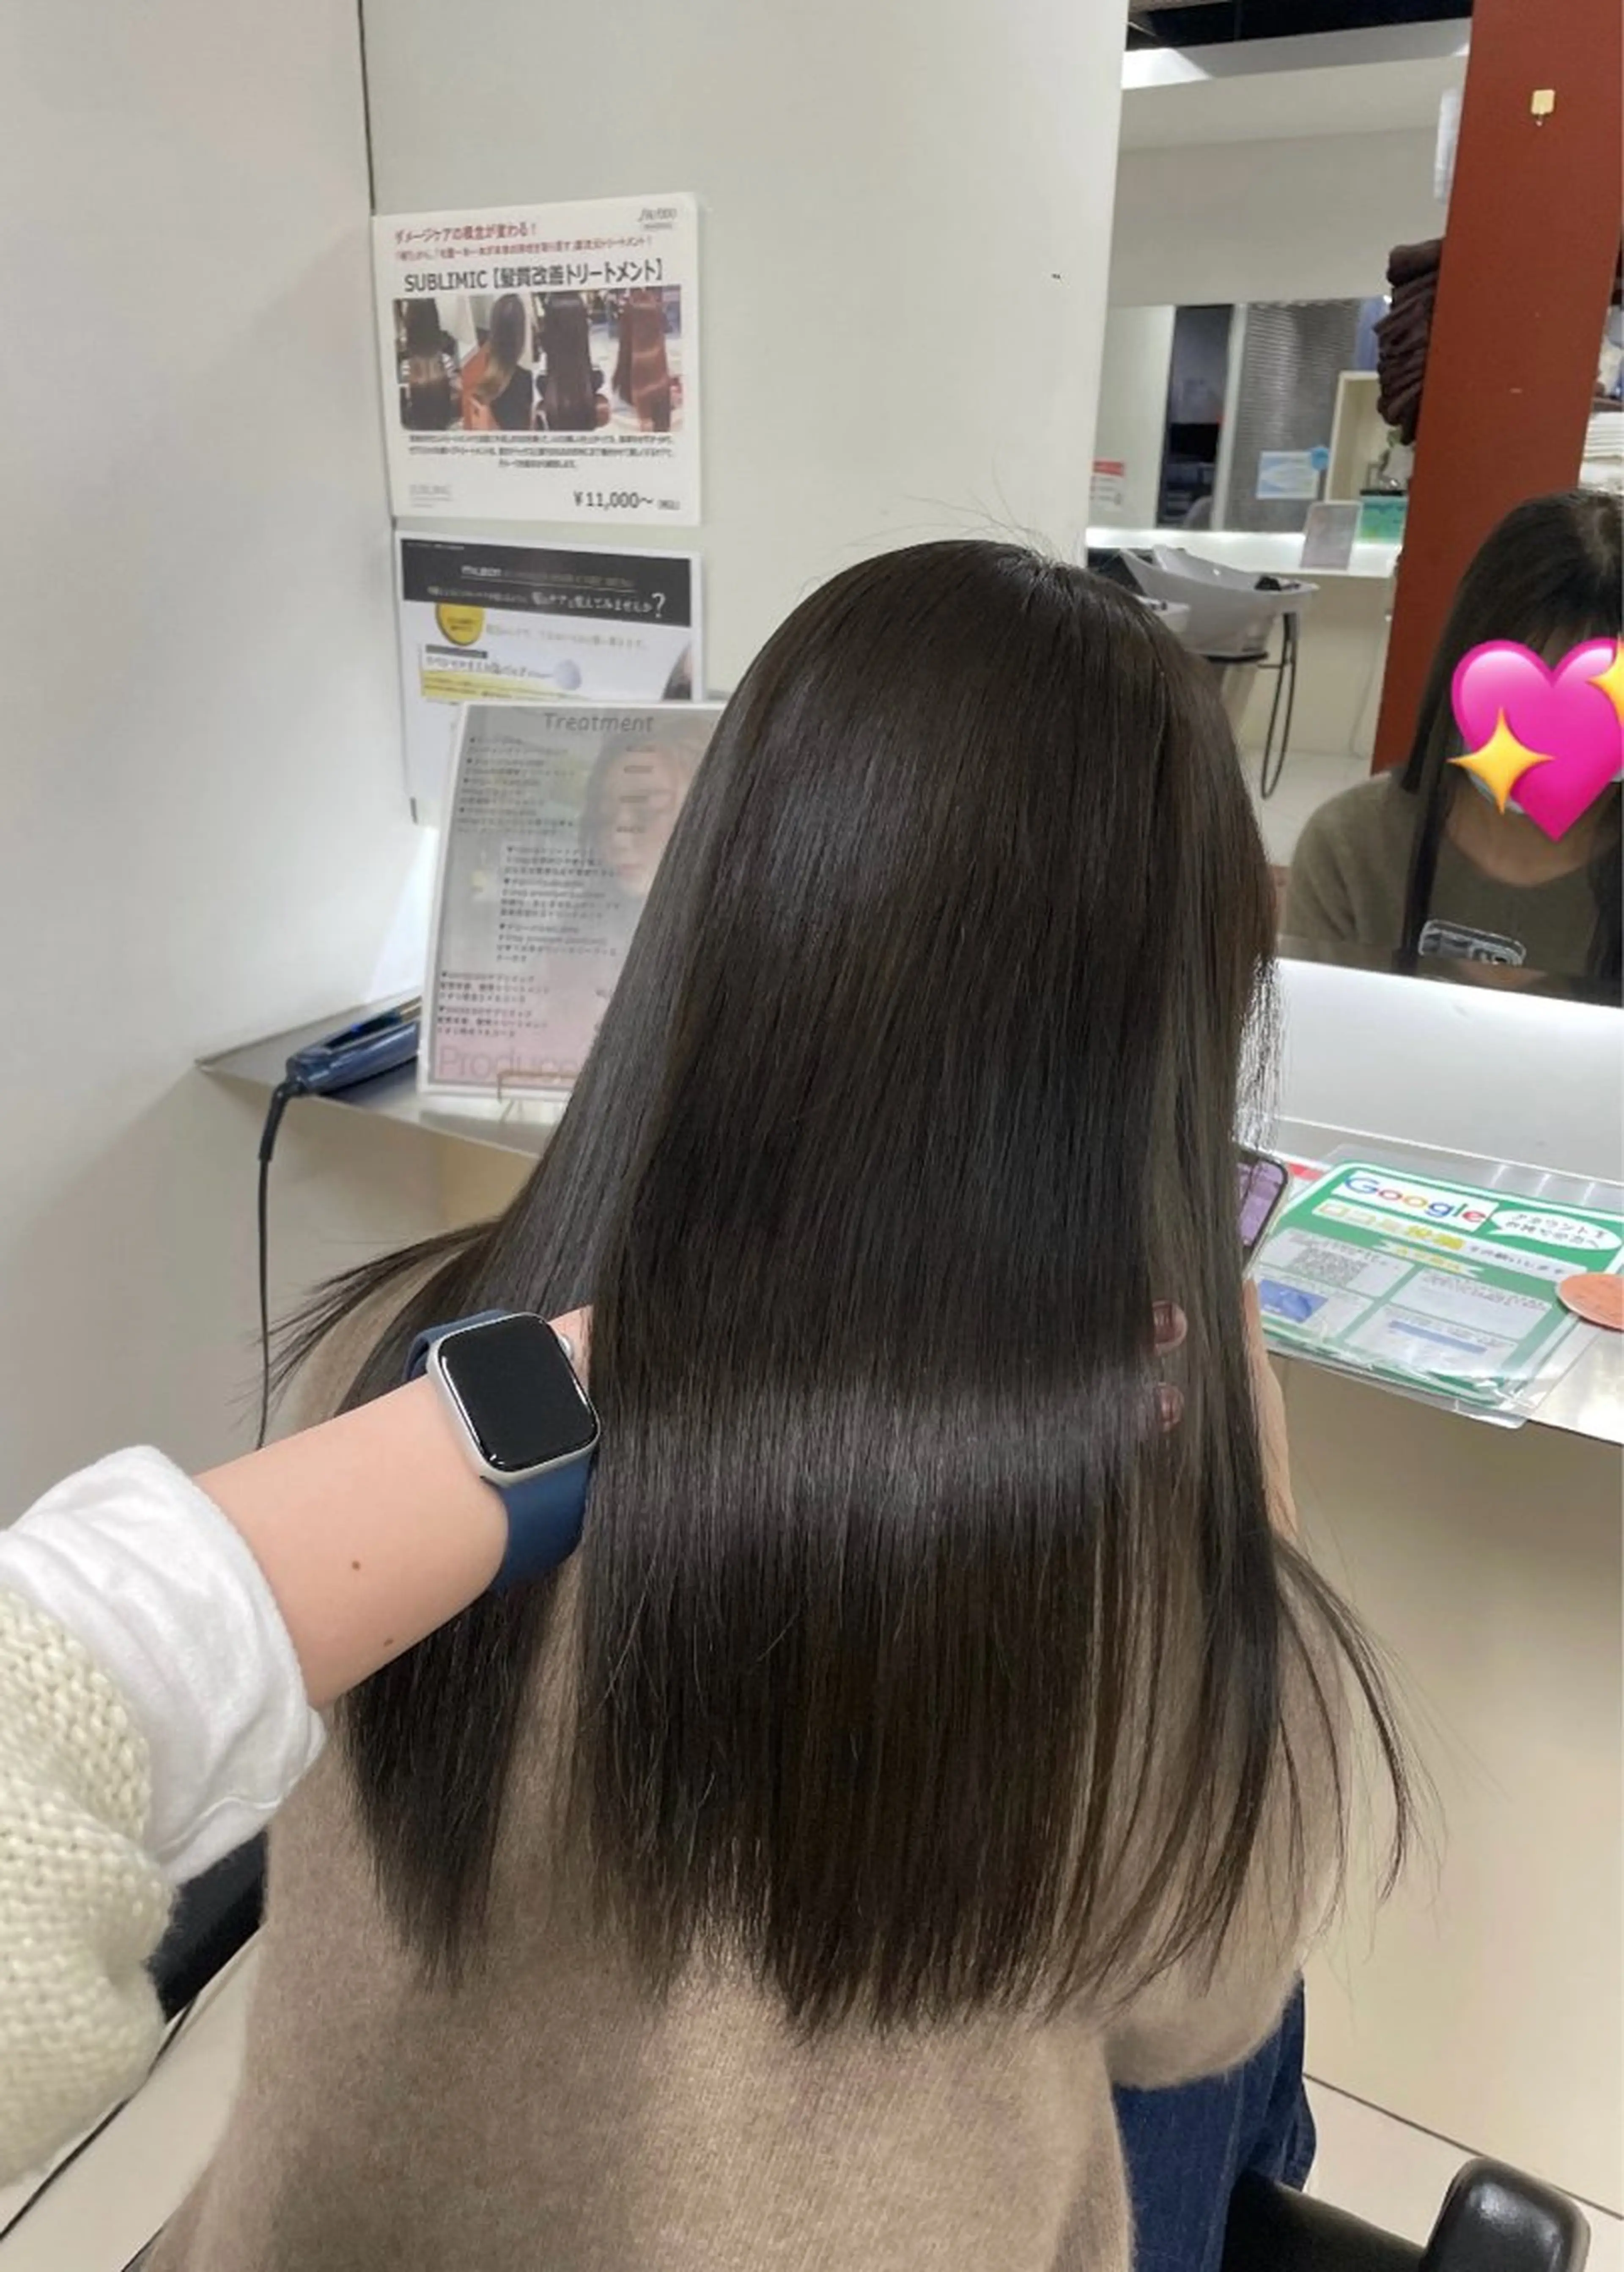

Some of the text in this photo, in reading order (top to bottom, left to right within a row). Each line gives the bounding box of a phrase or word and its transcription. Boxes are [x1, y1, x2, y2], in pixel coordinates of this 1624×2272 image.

[405, 270, 487, 292] SUBLIMIC
[544, 712, 654, 733] Treatment
[1346, 1174, 1487, 1223] Google
